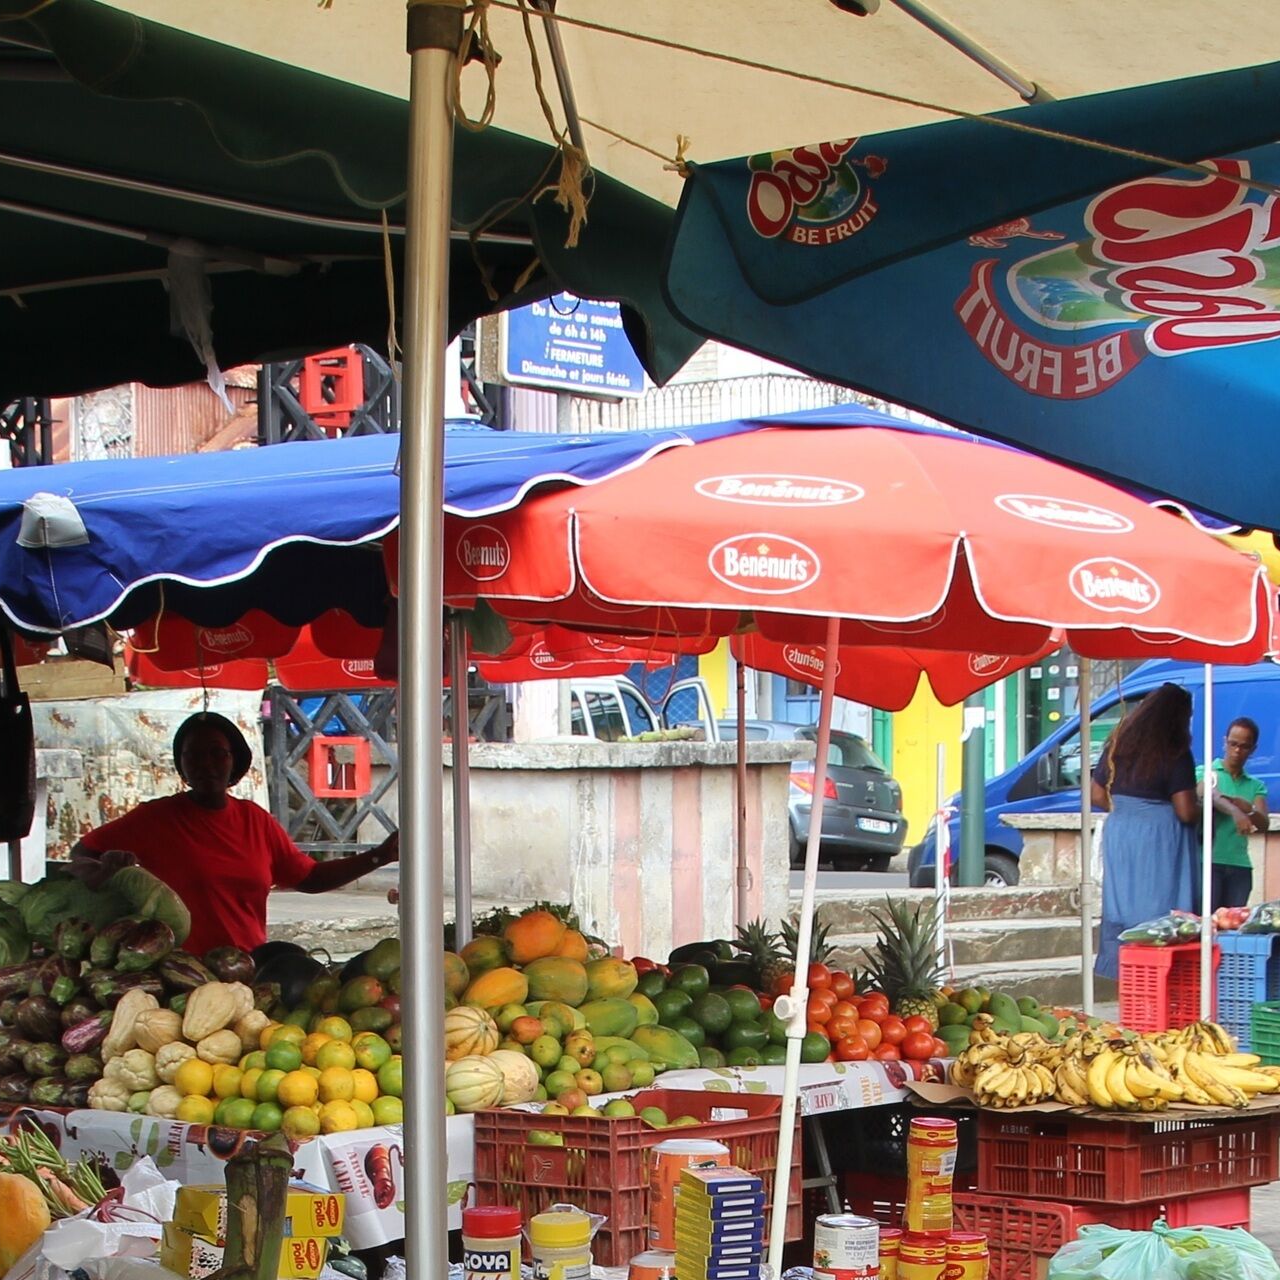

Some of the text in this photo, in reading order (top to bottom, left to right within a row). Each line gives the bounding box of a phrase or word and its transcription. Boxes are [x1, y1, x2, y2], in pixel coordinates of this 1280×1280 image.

[792, 190, 877, 245] BE FRUIT
[550, 347, 604, 368] FERMETURE
[522, 360, 567, 379] Dimanche
[569, 371, 580, 381] et
[464, 1253, 509, 1271] GOYA
